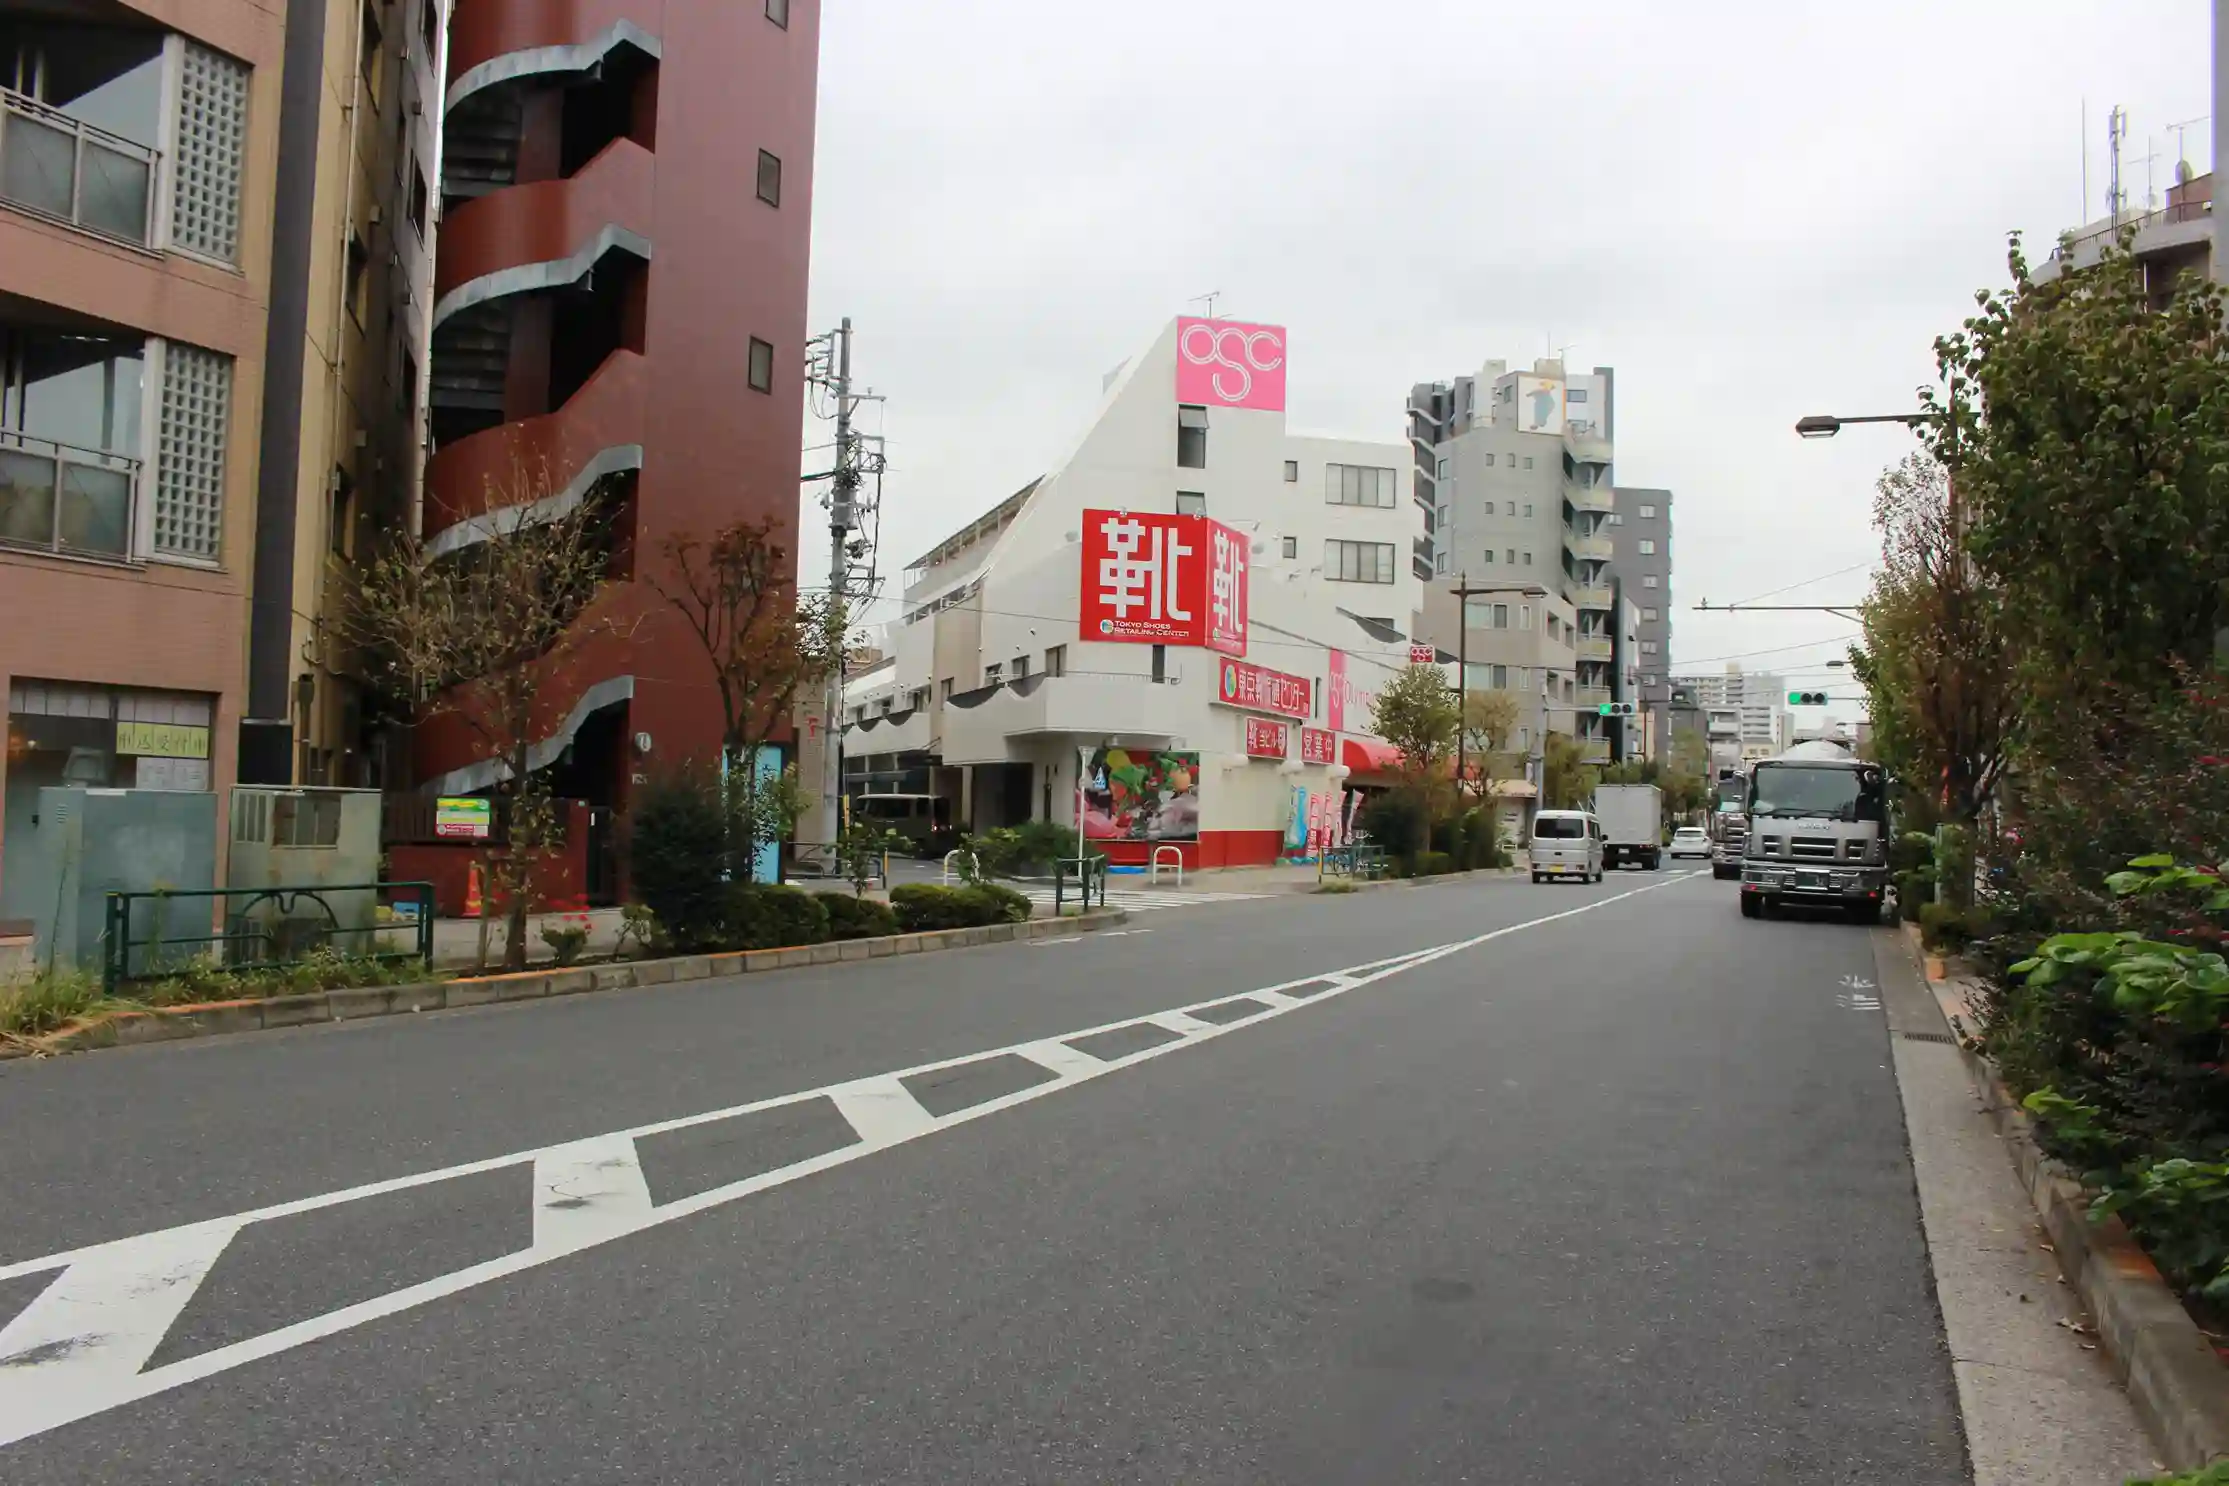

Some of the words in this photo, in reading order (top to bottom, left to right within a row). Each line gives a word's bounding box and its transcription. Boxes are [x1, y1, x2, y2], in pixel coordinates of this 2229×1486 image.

[1181, 324, 1283, 402] OSC
[1099, 517, 1193, 621] 靴
[1212, 529, 1244, 633] 靴
[1303, 729, 1333, 761] 営業中
